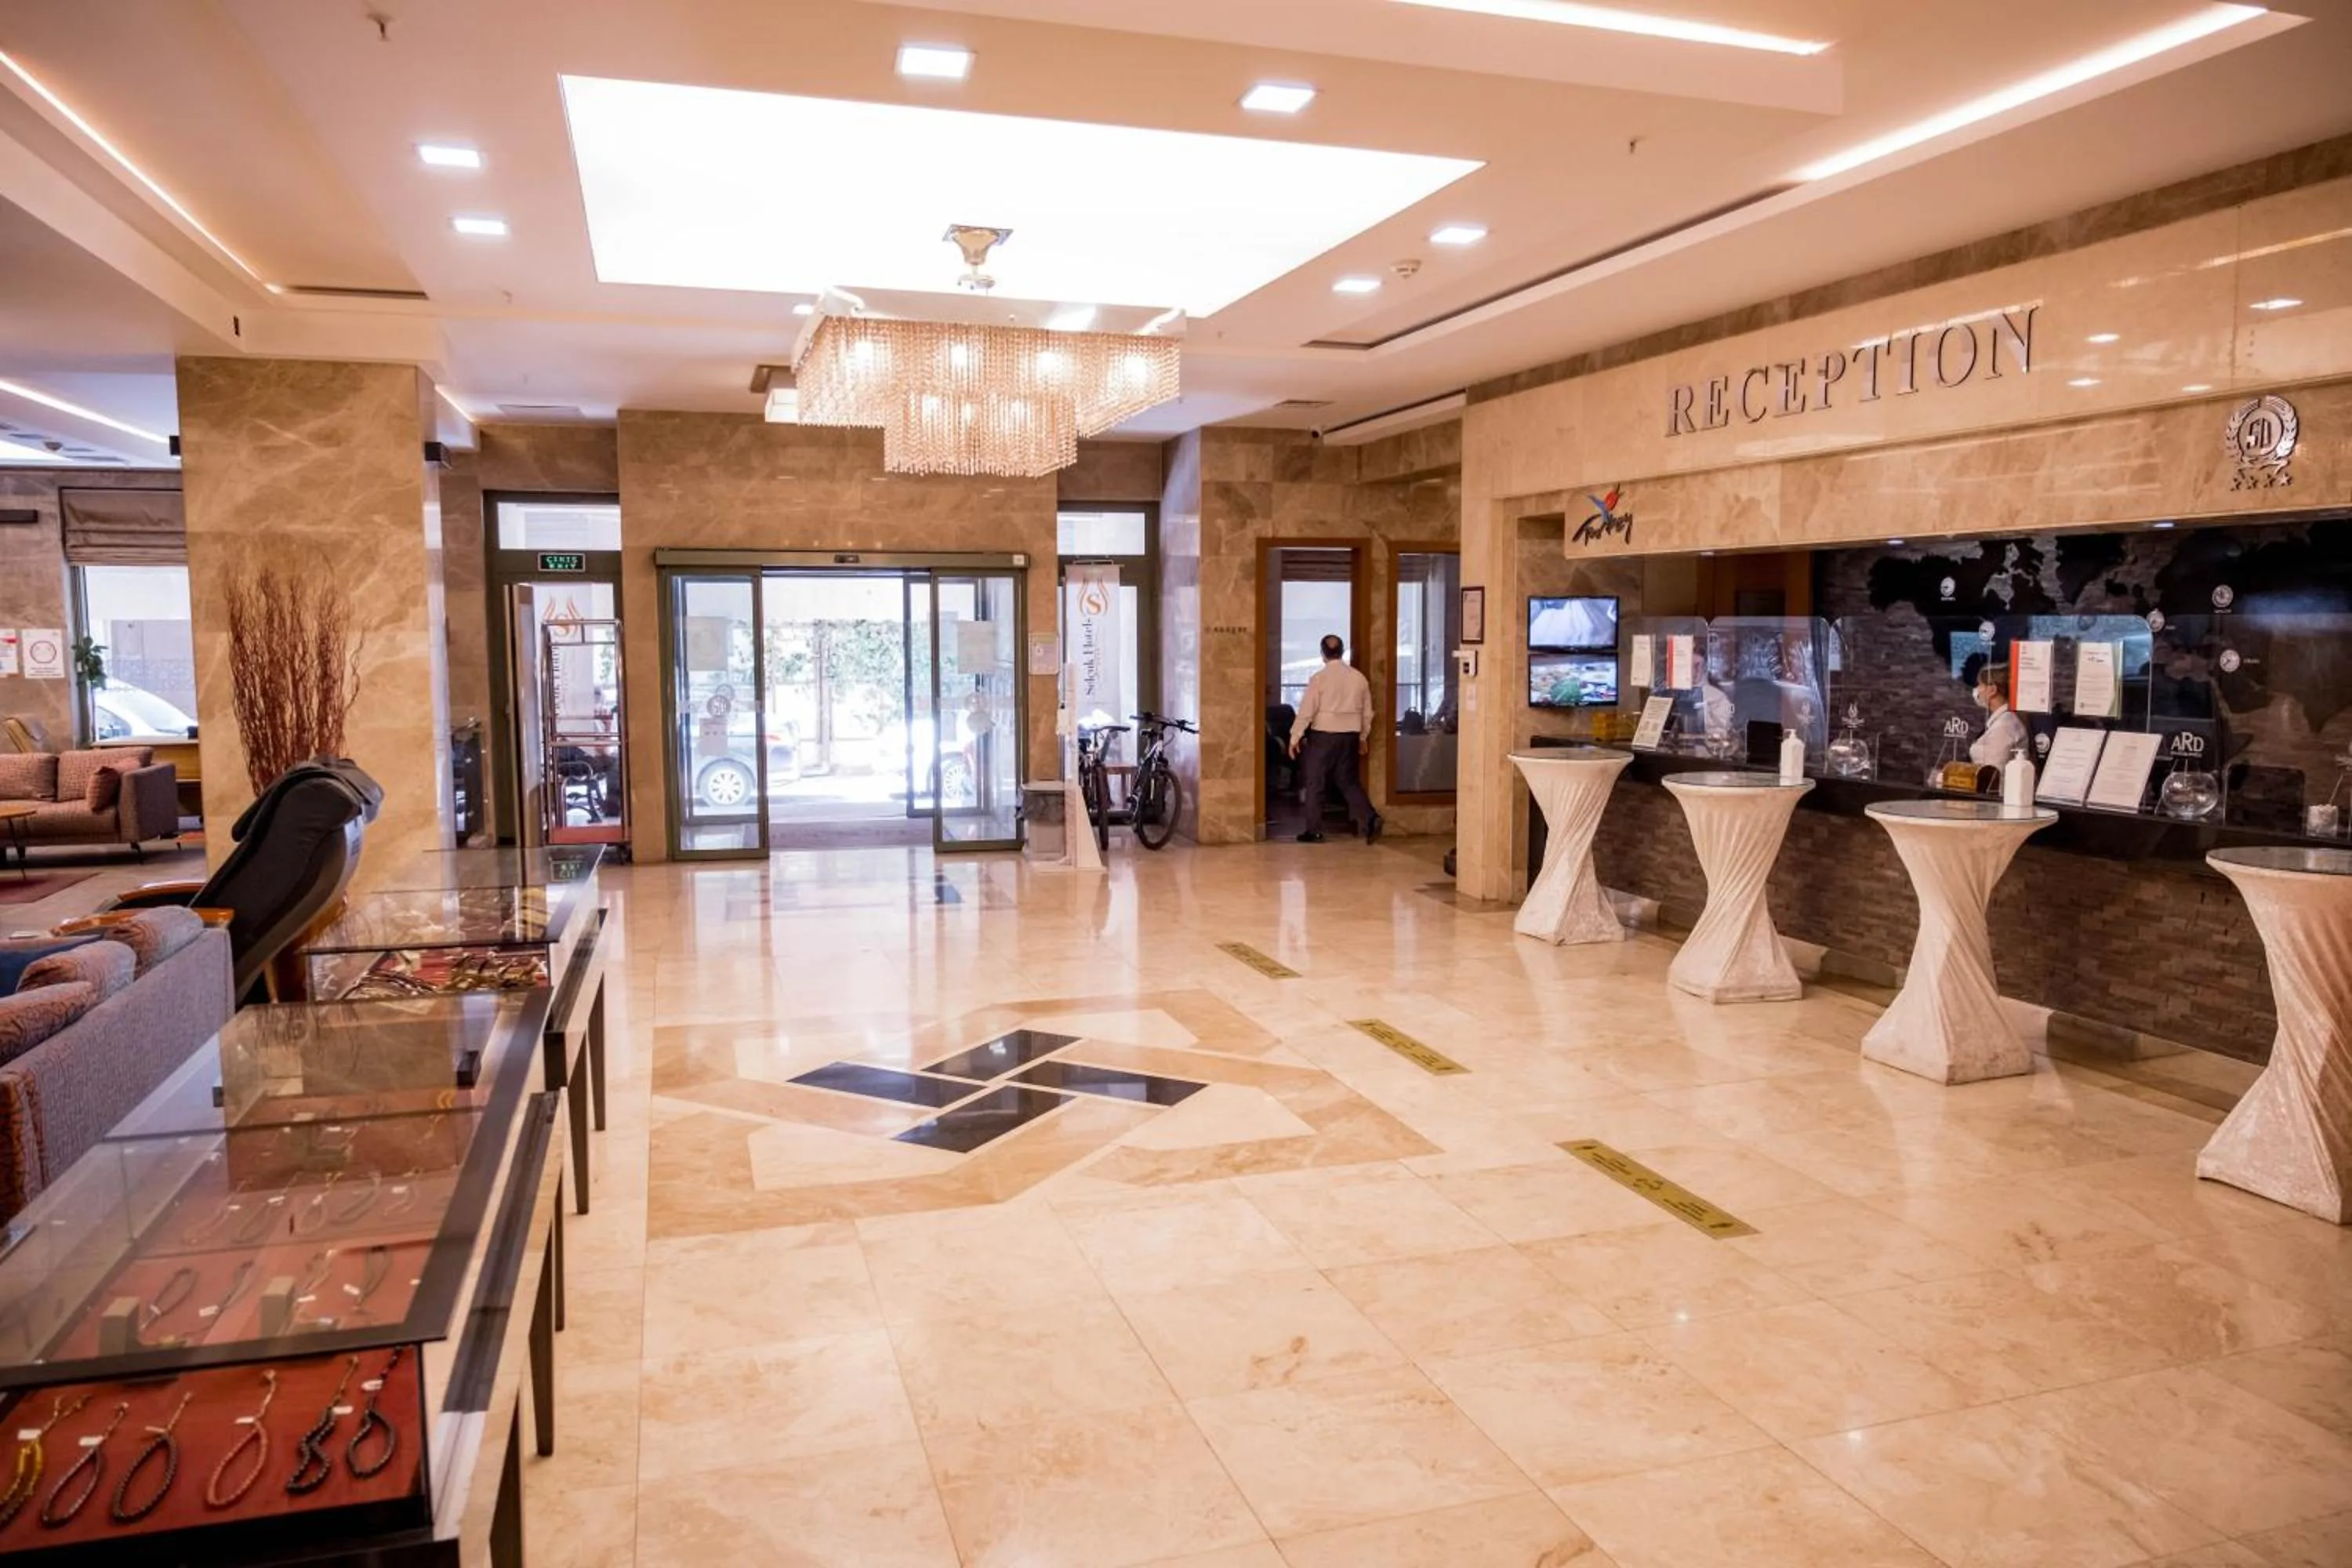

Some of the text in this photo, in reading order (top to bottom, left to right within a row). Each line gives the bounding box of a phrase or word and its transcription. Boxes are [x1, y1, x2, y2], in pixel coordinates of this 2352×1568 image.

[1665, 306, 2042, 437] RECEPTION
[1944, 717, 1969, 734] ARD
[2171, 731, 2204, 752] ARD
